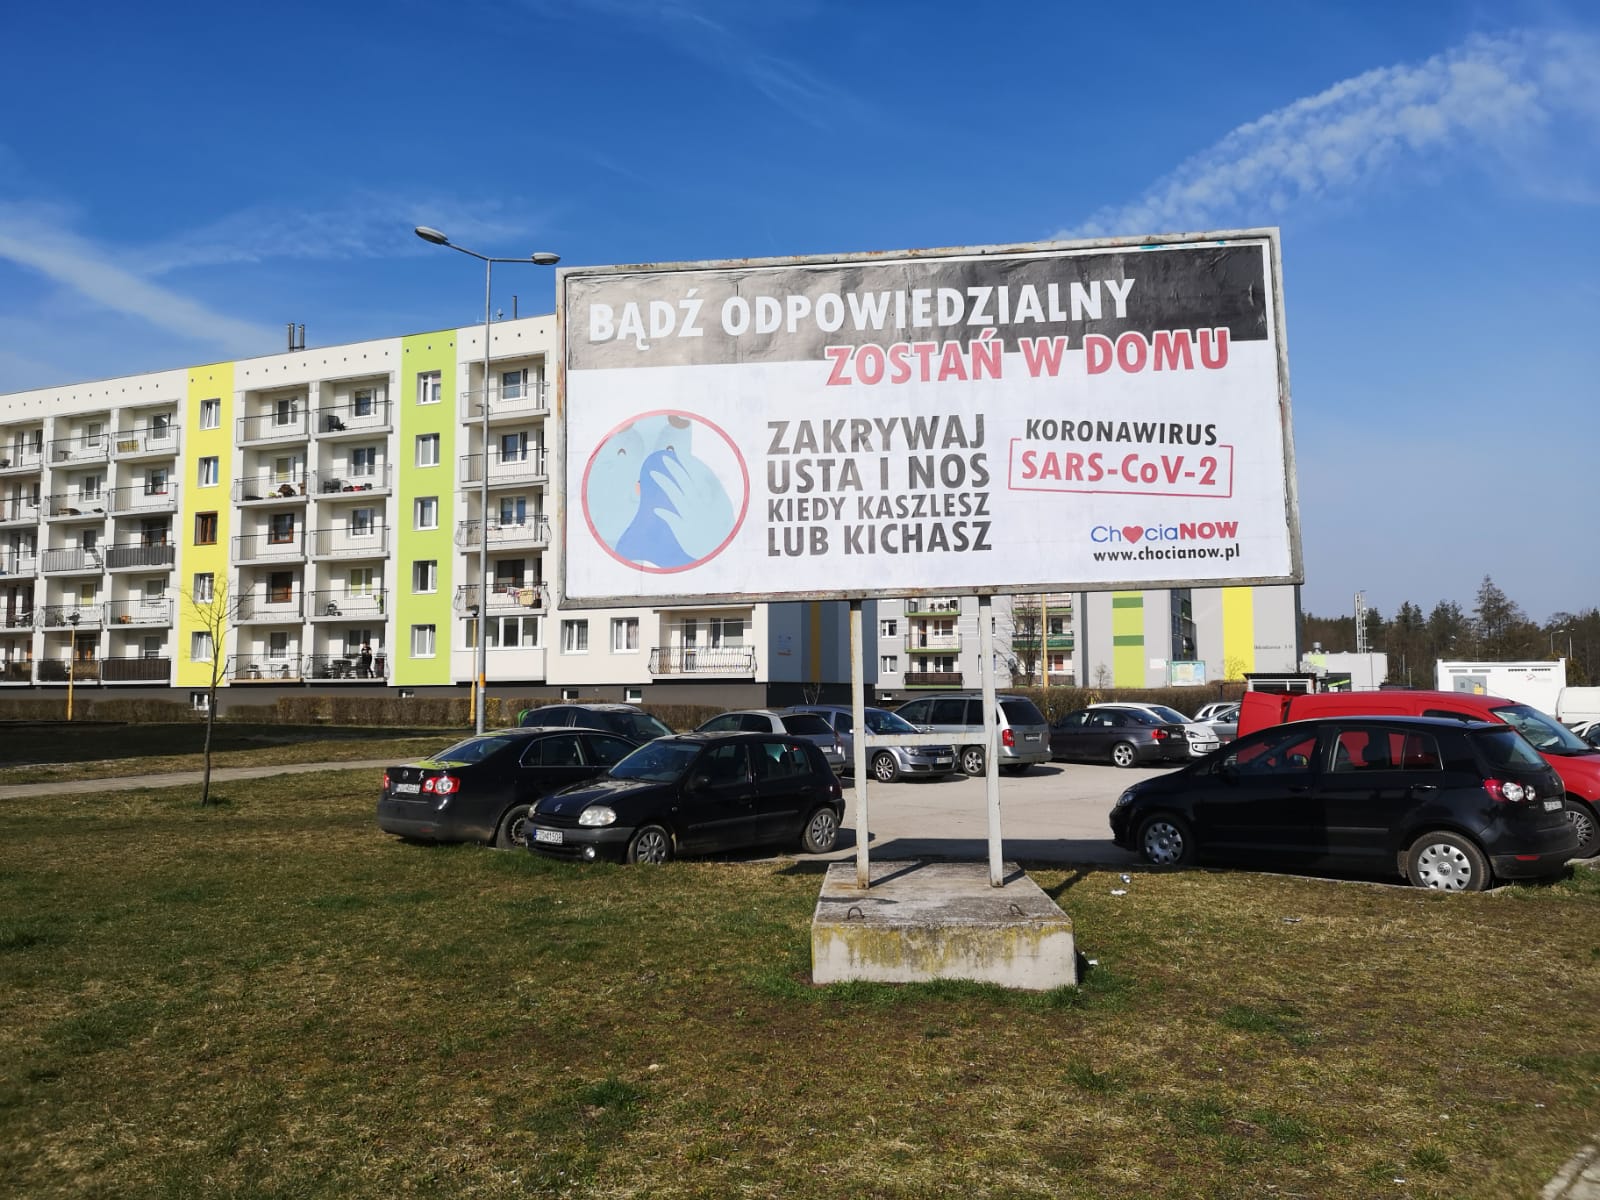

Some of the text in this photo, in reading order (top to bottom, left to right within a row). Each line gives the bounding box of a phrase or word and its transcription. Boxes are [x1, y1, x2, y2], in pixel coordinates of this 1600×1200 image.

[589, 278, 1136, 351] BĄDŹ ODPOWIEDZIALNY
[825, 327, 1230, 386] ZOSTAŃ W DOMU
[766, 413, 985, 455] ZAKRYWAJ
[1026, 418, 1217, 446] KORONAWIRUS
[767, 453, 990, 494] USTA I NOS
[1021, 449, 1218, 486] SARS-CoV-2
[767, 491, 991, 523] KIEDY KASZLESZ
[767, 520, 993, 557] LUB KICHASZ
[1093, 543, 1240, 562] www.chocianow.pl
